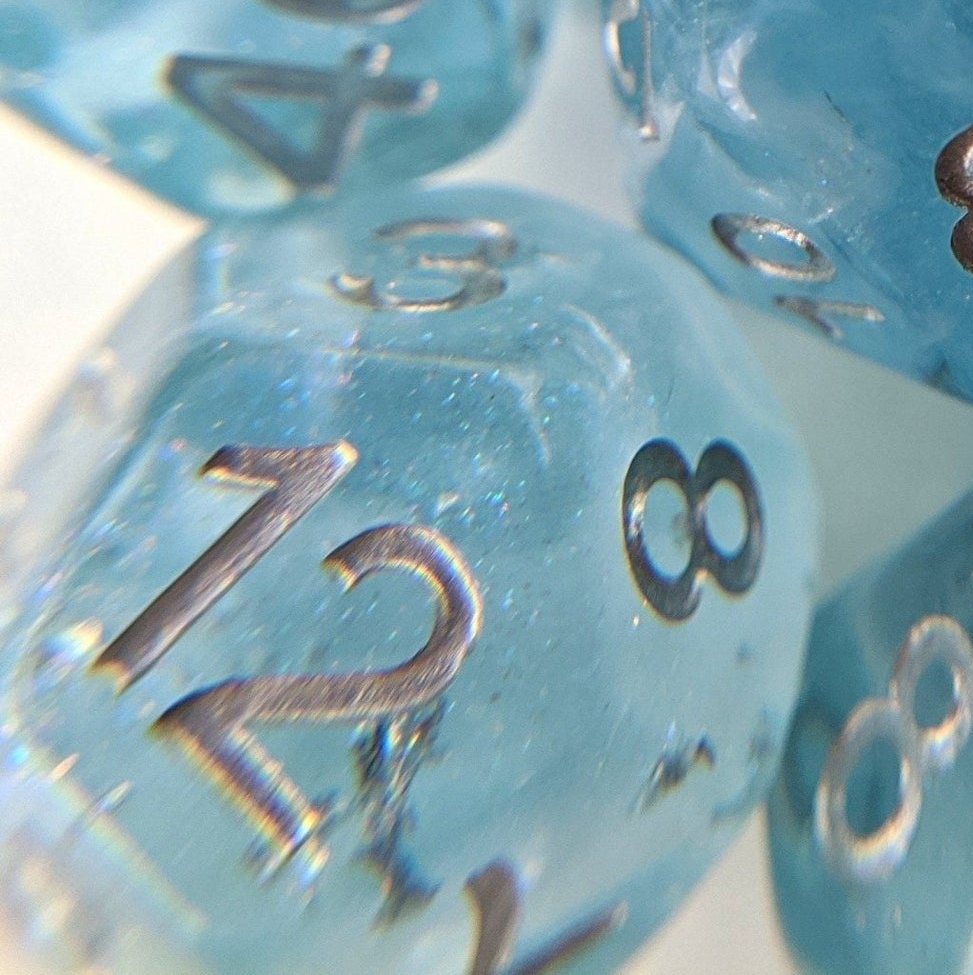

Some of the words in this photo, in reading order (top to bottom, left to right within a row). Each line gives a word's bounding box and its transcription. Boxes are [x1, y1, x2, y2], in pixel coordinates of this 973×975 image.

[328, 217, 520, 312] 3
[621, 436, 765, 624] 8
[92, 438, 485, 857] 12
